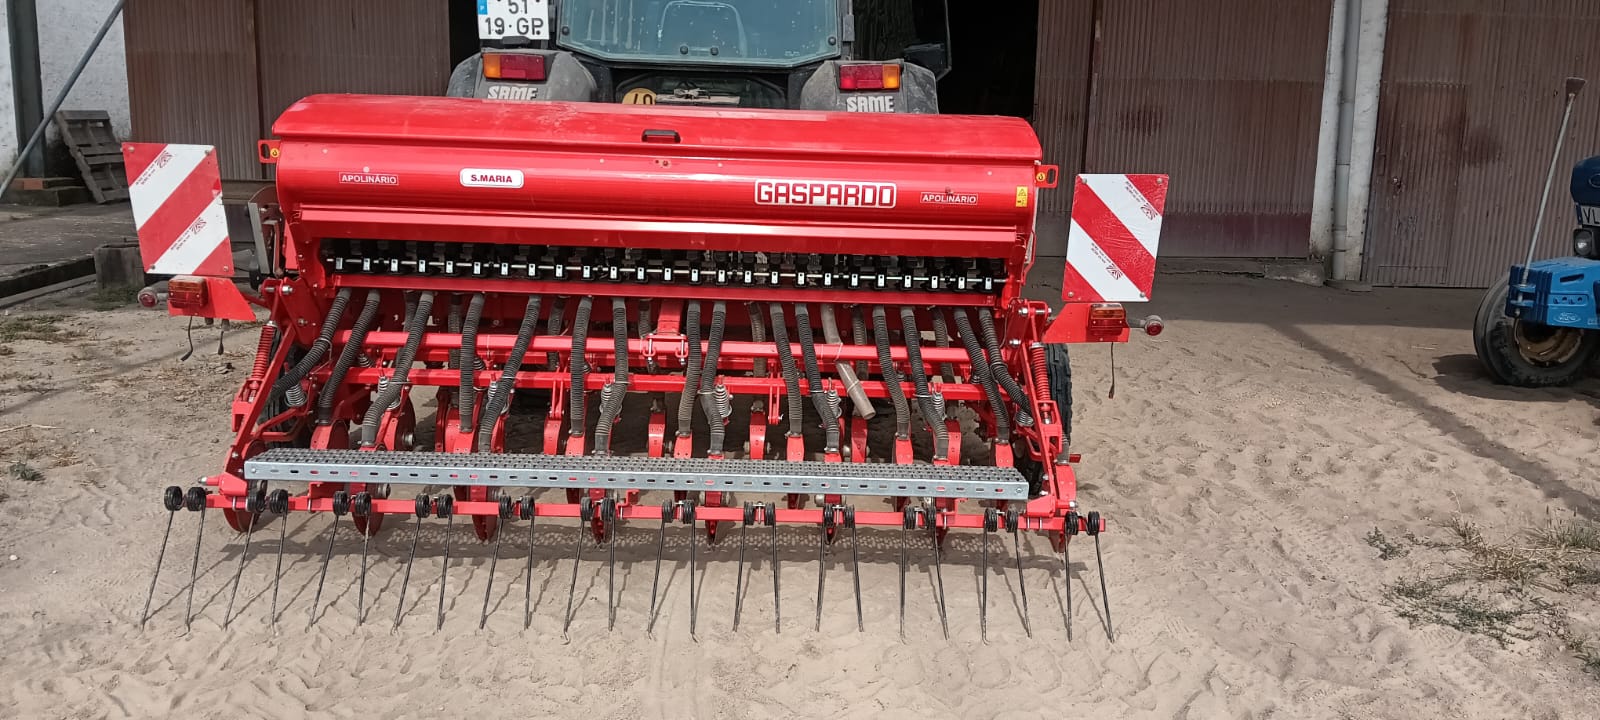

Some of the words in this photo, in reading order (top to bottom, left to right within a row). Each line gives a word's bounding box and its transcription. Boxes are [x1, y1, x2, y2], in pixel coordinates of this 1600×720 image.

[487, 85, 537, 100] SAME
[847, 95, 895, 112] SAME
[341, 173, 397, 184] APOLINÁRIO
[471, 174, 513, 184] S.MARIA
[757, 182, 895, 208] GASPARDO
[922, 194, 977, 204] APOLINÁRIO
